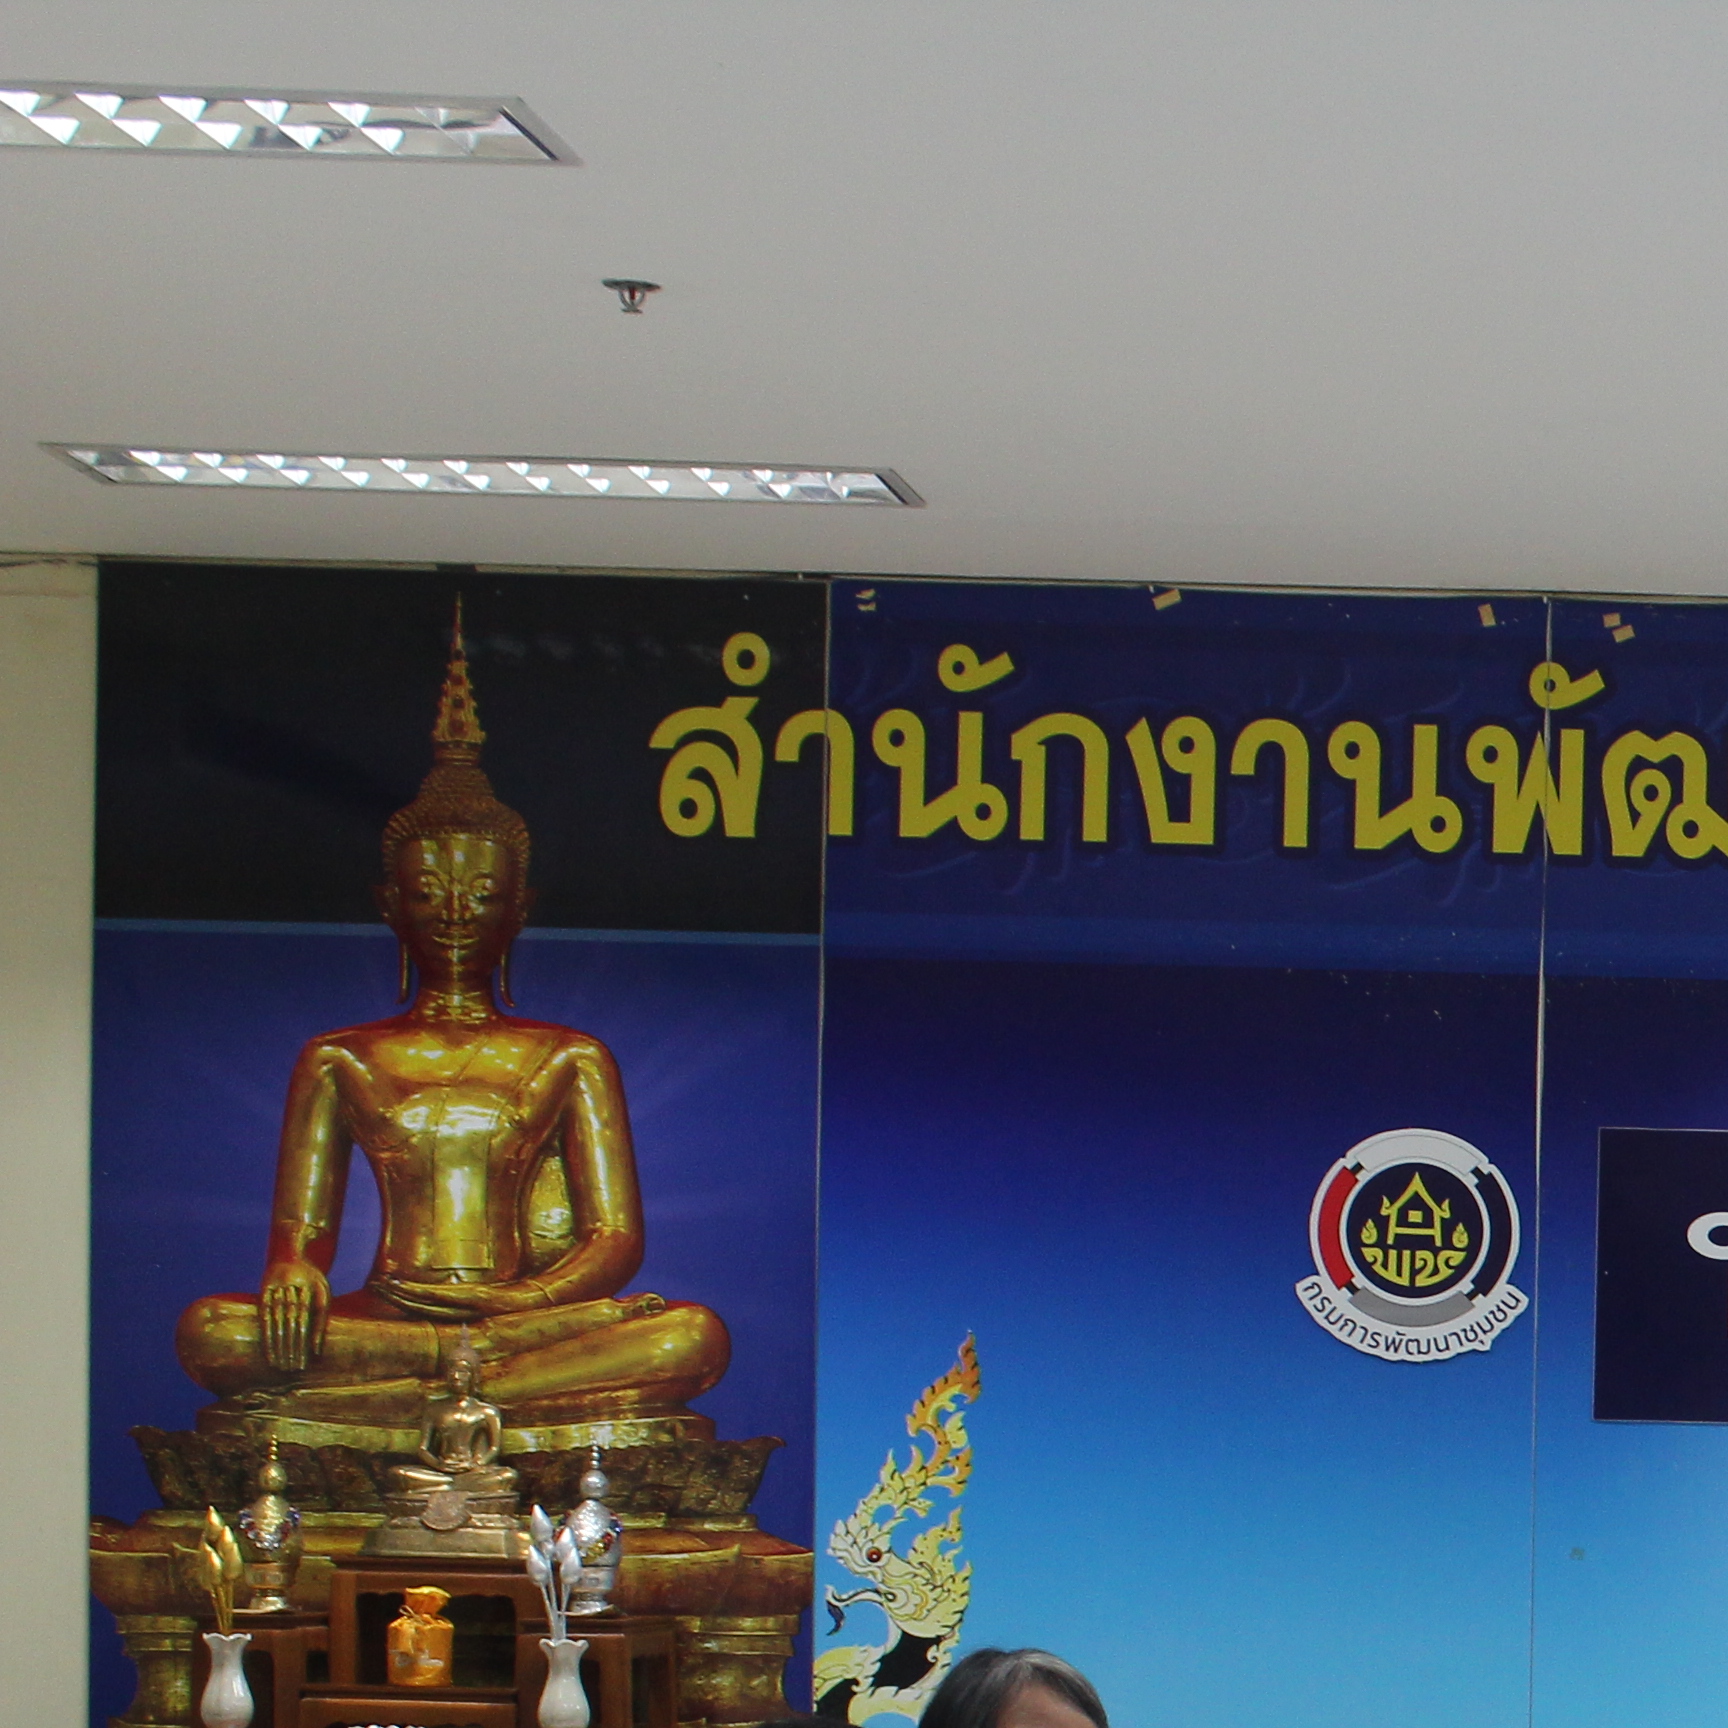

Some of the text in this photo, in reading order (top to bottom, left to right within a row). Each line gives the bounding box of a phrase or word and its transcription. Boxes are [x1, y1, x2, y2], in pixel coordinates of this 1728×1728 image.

[1302, 1281, 1522, 1356] กรมการพัฒนาชุมชน
